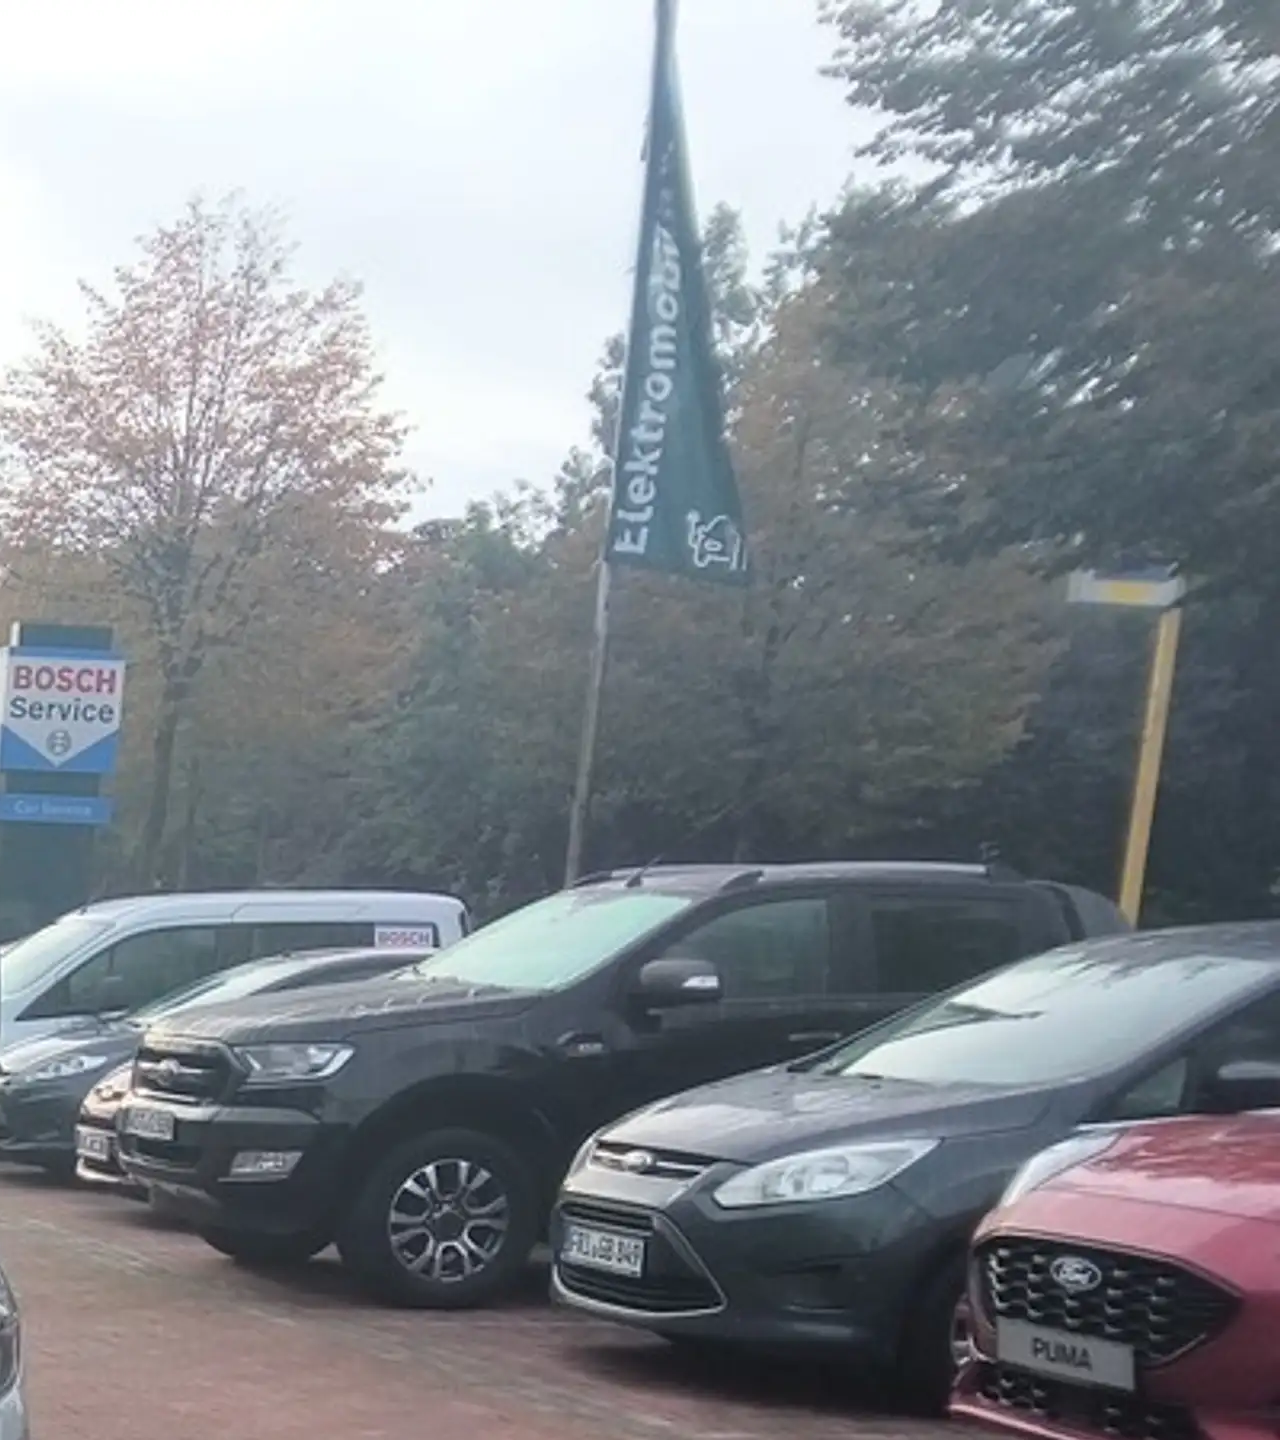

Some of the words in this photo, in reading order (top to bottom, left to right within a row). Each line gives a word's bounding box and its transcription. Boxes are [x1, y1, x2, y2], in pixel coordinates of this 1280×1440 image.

[13, 665, 117, 694] BOSCH
[9, 696, 115, 724] Service
[1032, 1337, 1093, 1371] PUMA
